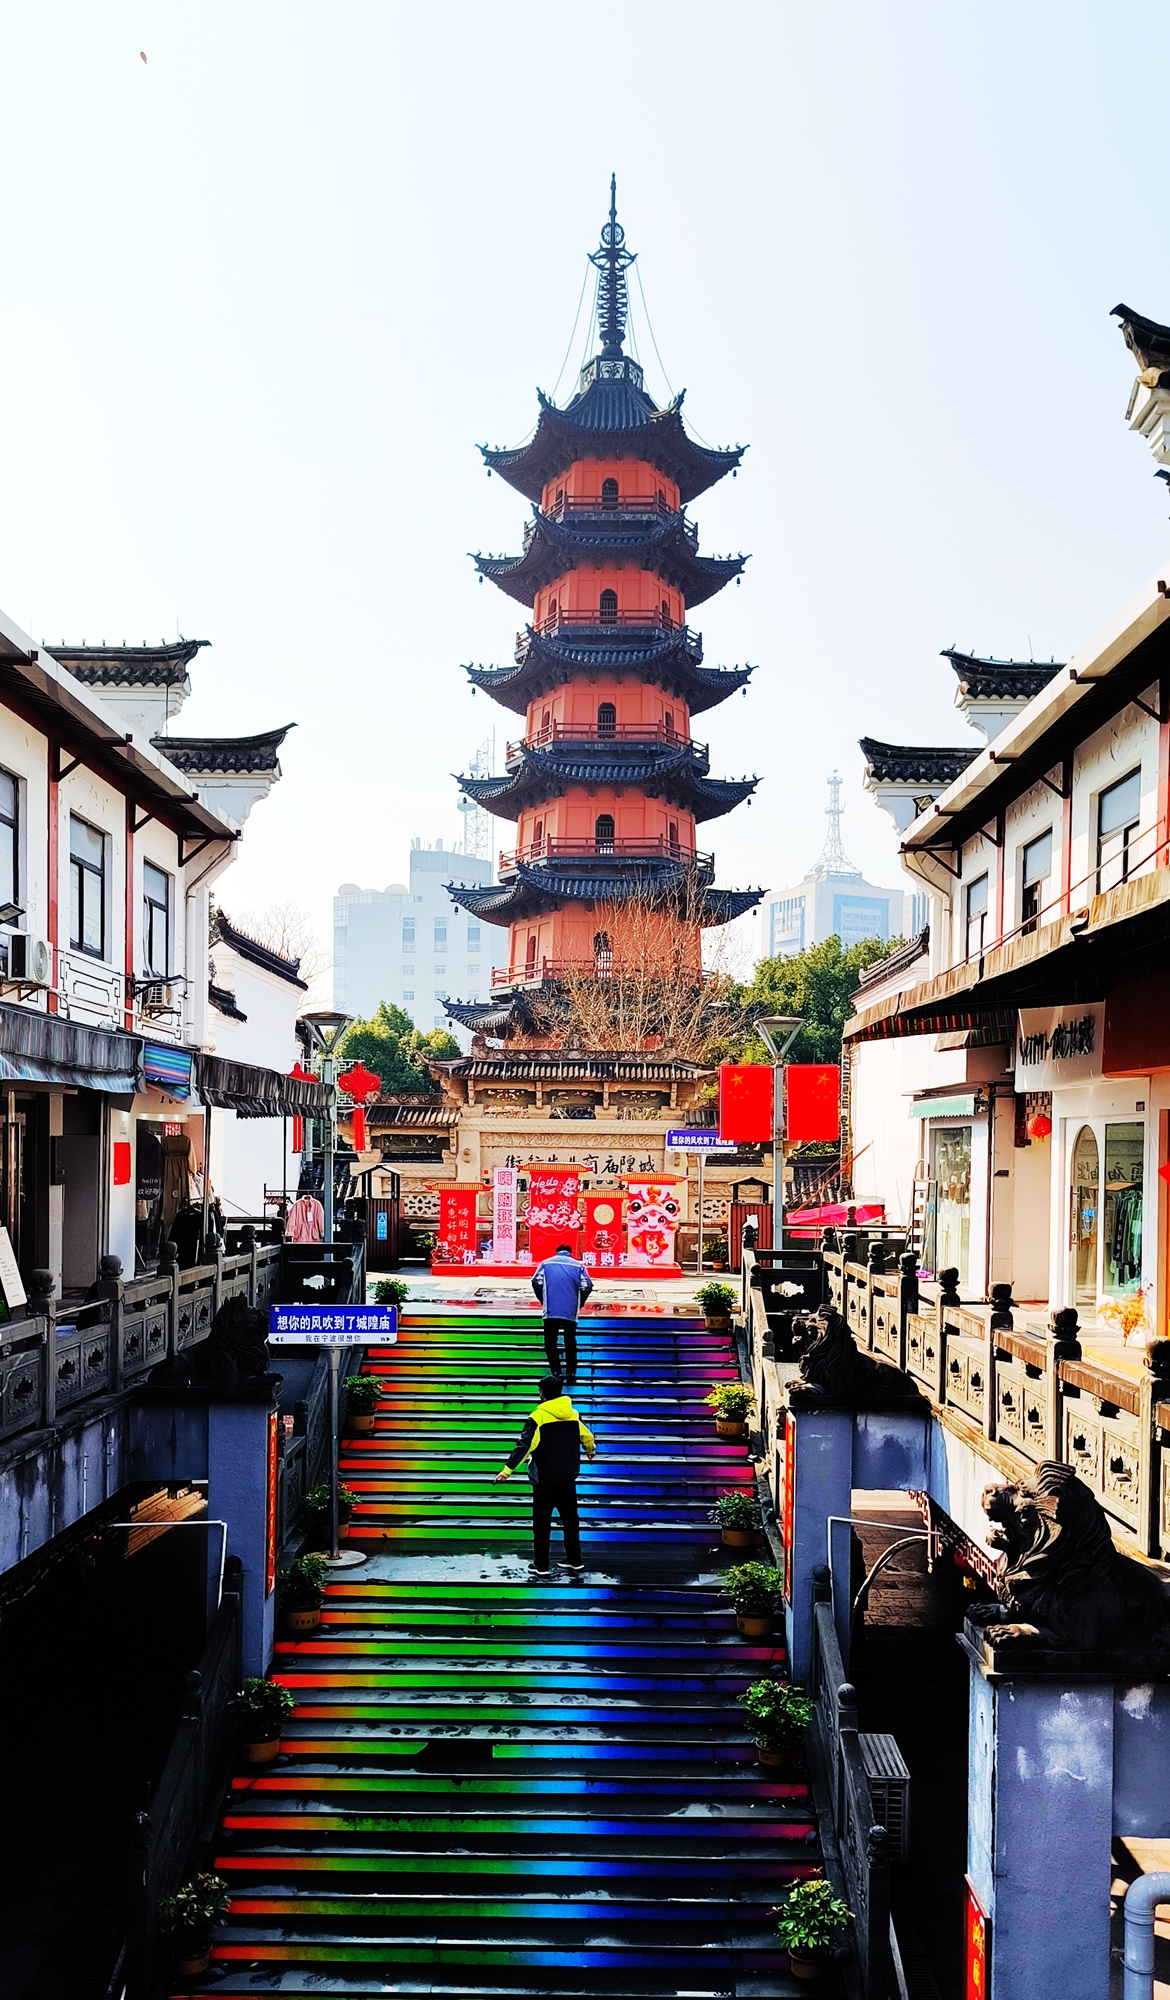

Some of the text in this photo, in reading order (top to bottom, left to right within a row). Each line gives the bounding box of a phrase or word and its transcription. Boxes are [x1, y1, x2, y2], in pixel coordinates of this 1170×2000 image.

[497, 1170, 513, 1239] 嗨购狂欢
[277, 1315, 390, 1330] 想你的风吹到了城隍庙
